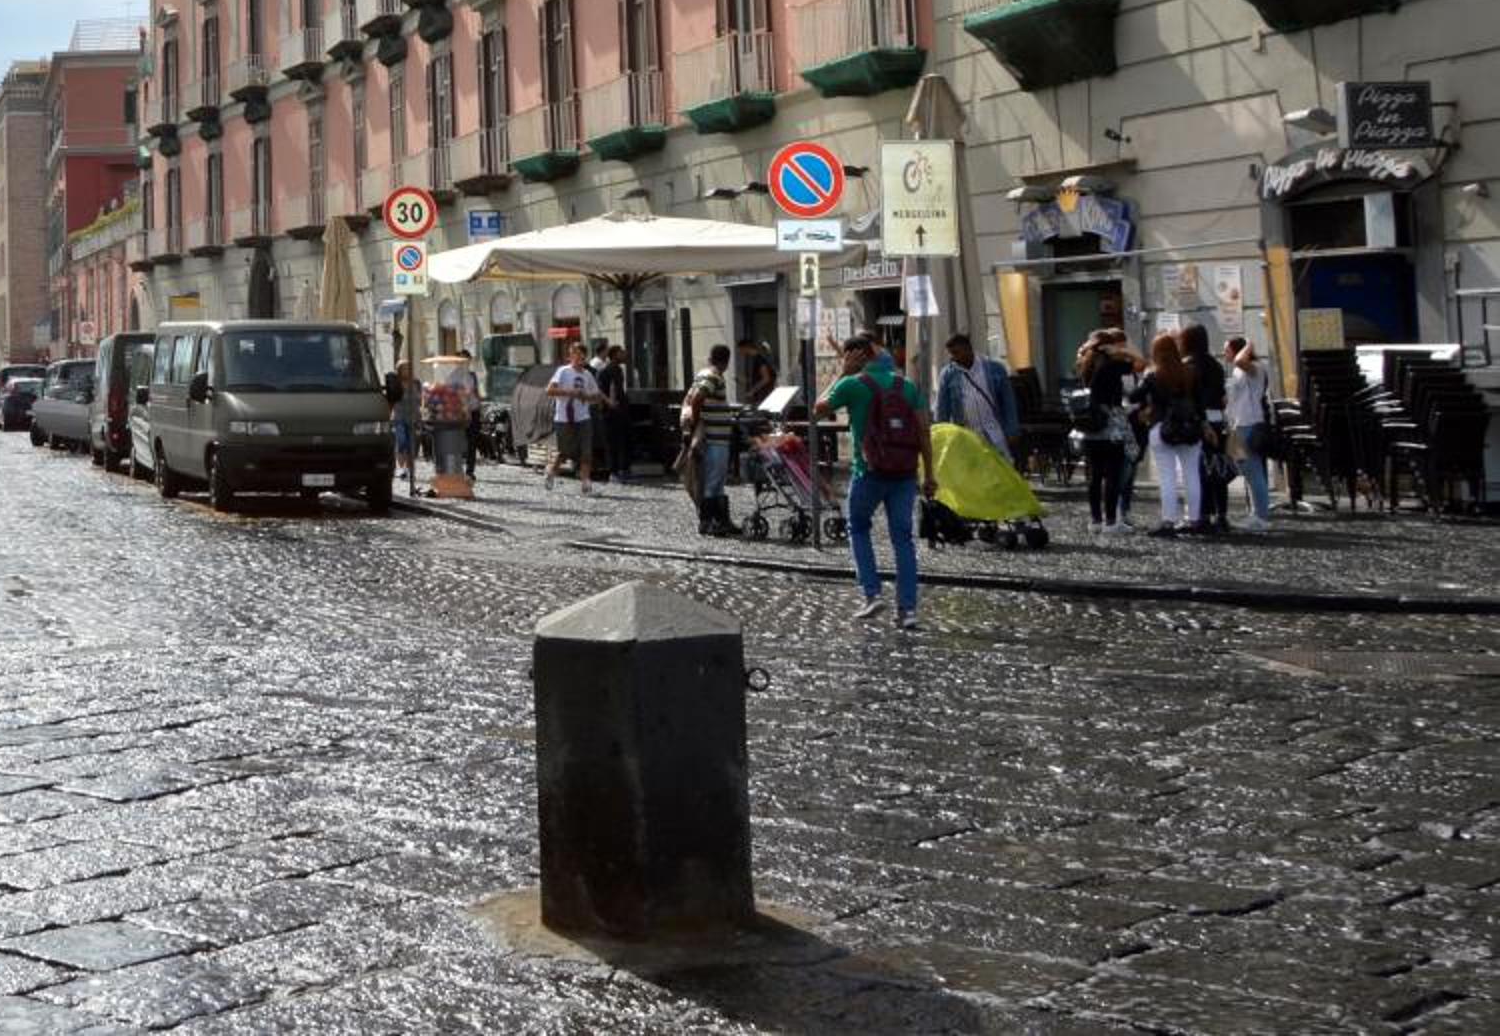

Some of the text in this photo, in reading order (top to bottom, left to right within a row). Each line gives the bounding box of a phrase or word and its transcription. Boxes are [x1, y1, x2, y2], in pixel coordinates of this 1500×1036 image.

[1358, 85, 1416, 110] Pizza
[1353, 120, 1427, 143] Piazza
[397, 202, 423, 223] 30
